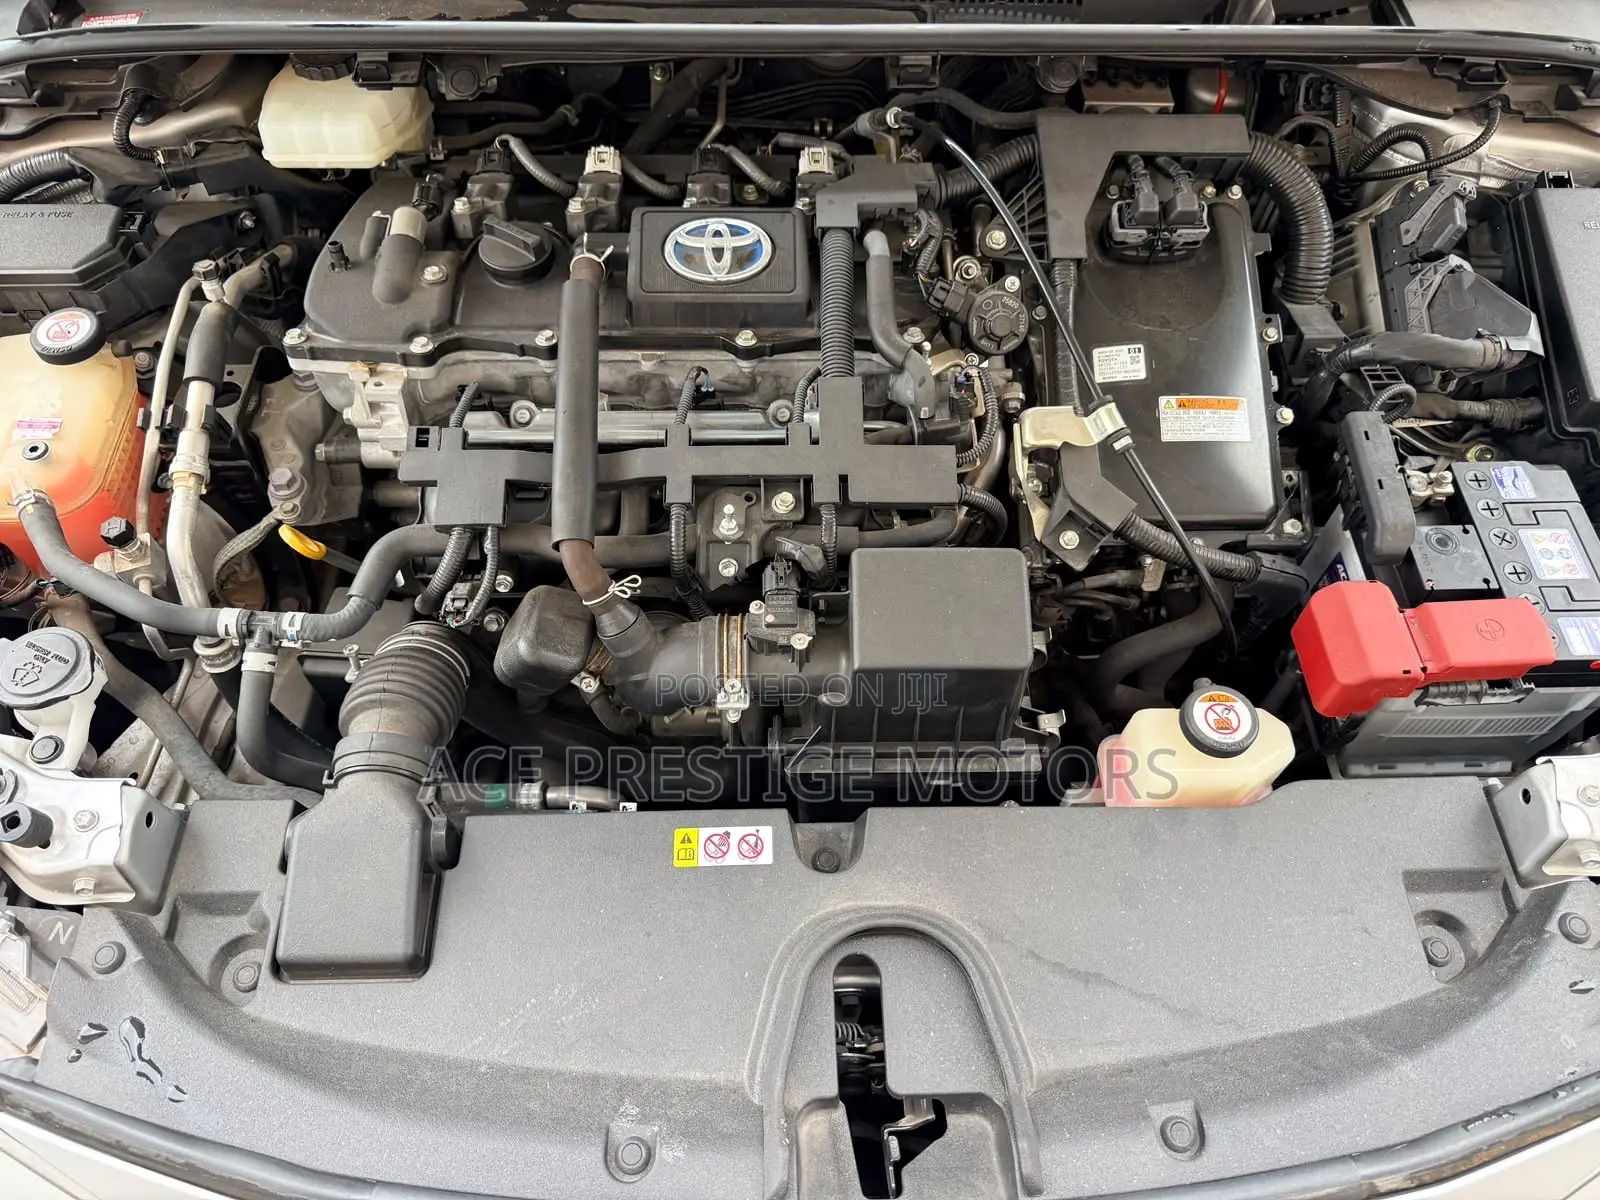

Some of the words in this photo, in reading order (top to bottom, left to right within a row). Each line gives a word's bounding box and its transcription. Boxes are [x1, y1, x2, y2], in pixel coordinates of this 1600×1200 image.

[2, 211, 36, 219] RELAY
[40, 344, 73, 354] DENSO
[25, 640, 52, 657] WASHER
[50, 652, 71, 665] FLUID
[33, 653, 51, 664] ONLY
